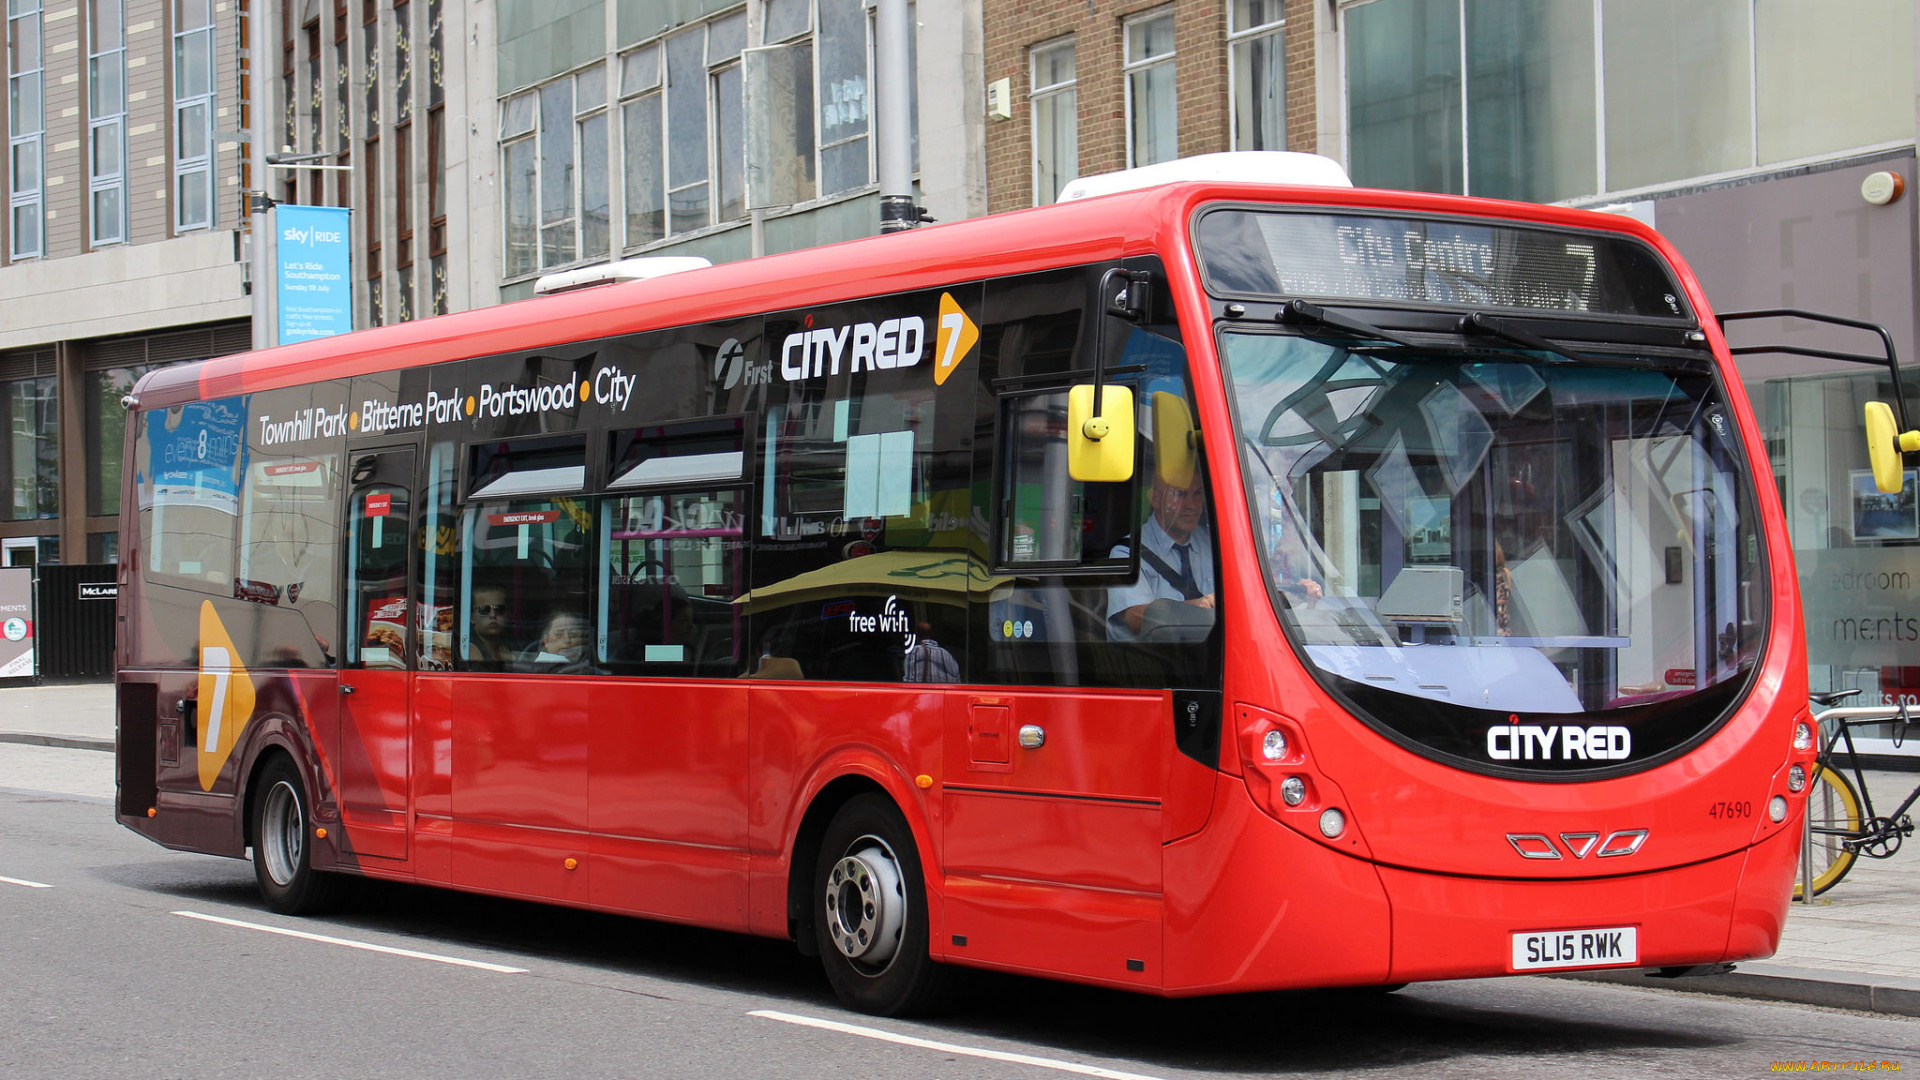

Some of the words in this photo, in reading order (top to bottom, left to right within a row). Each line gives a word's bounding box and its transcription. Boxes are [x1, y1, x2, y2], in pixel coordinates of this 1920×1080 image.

[284, 227, 308, 244] sky
[315, 231, 341, 243] RIDE
[1338, 226, 1394, 267] City
[1404, 229, 1495, 275] Centre
[284, 270, 341, 281] Southampton
[305, 262, 323, 271] Ride
[1566, 243, 1596, 311] 7
[781, 313, 850, 382] CITY
[851, 316, 925, 373] RED
[941, 312, 964, 367] 7
[744, 360, 774, 386] First
[259, 407, 313, 446] Townhill
[314, 403, 348, 439] Park
[361, 398, 422, 433] Bitterne
[426, 387, 463, 426] Park
[478, 371, 577, 419] Portswood
[594, 365, 637, 412] City
[197, 429, 207, 459] 8
[849, 610, 876, 632] free
[203, 646, 230, 752] 7
[1487, 715, 1559, 760] CITY
[1561, 725, 1632, 760] RED
[1709, 801, 1752, 819] 47690
[1527, 934, 1575, 963] SL15
[1581, 932, 1622, 959] RWK
